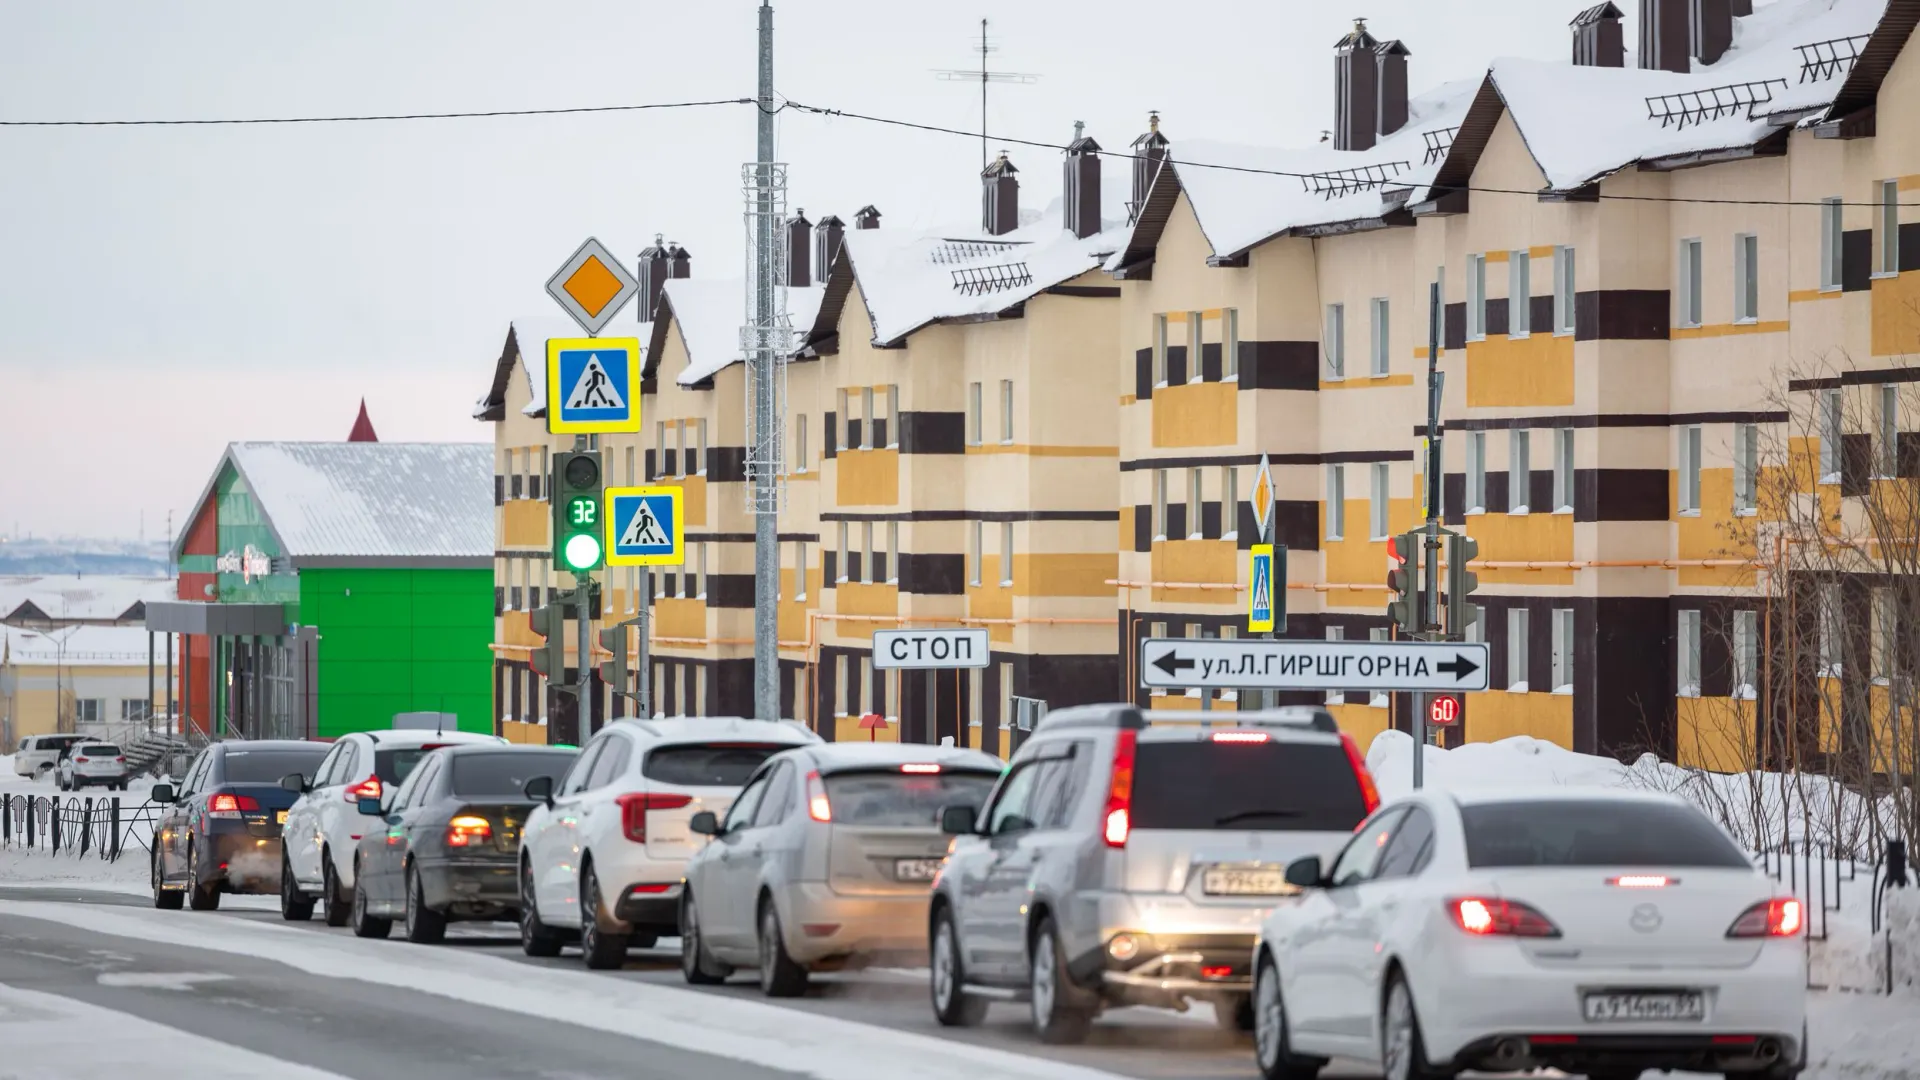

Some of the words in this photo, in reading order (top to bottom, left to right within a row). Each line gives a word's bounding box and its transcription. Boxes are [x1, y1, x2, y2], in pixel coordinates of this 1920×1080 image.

[574, 500, 595, 523] 32
[891, 637, 971, 660] СТОП
[1202, 654, 1429, 679] ул.Л.ГИРШГОРНА
[1432, 699, 1453, 721] 60
